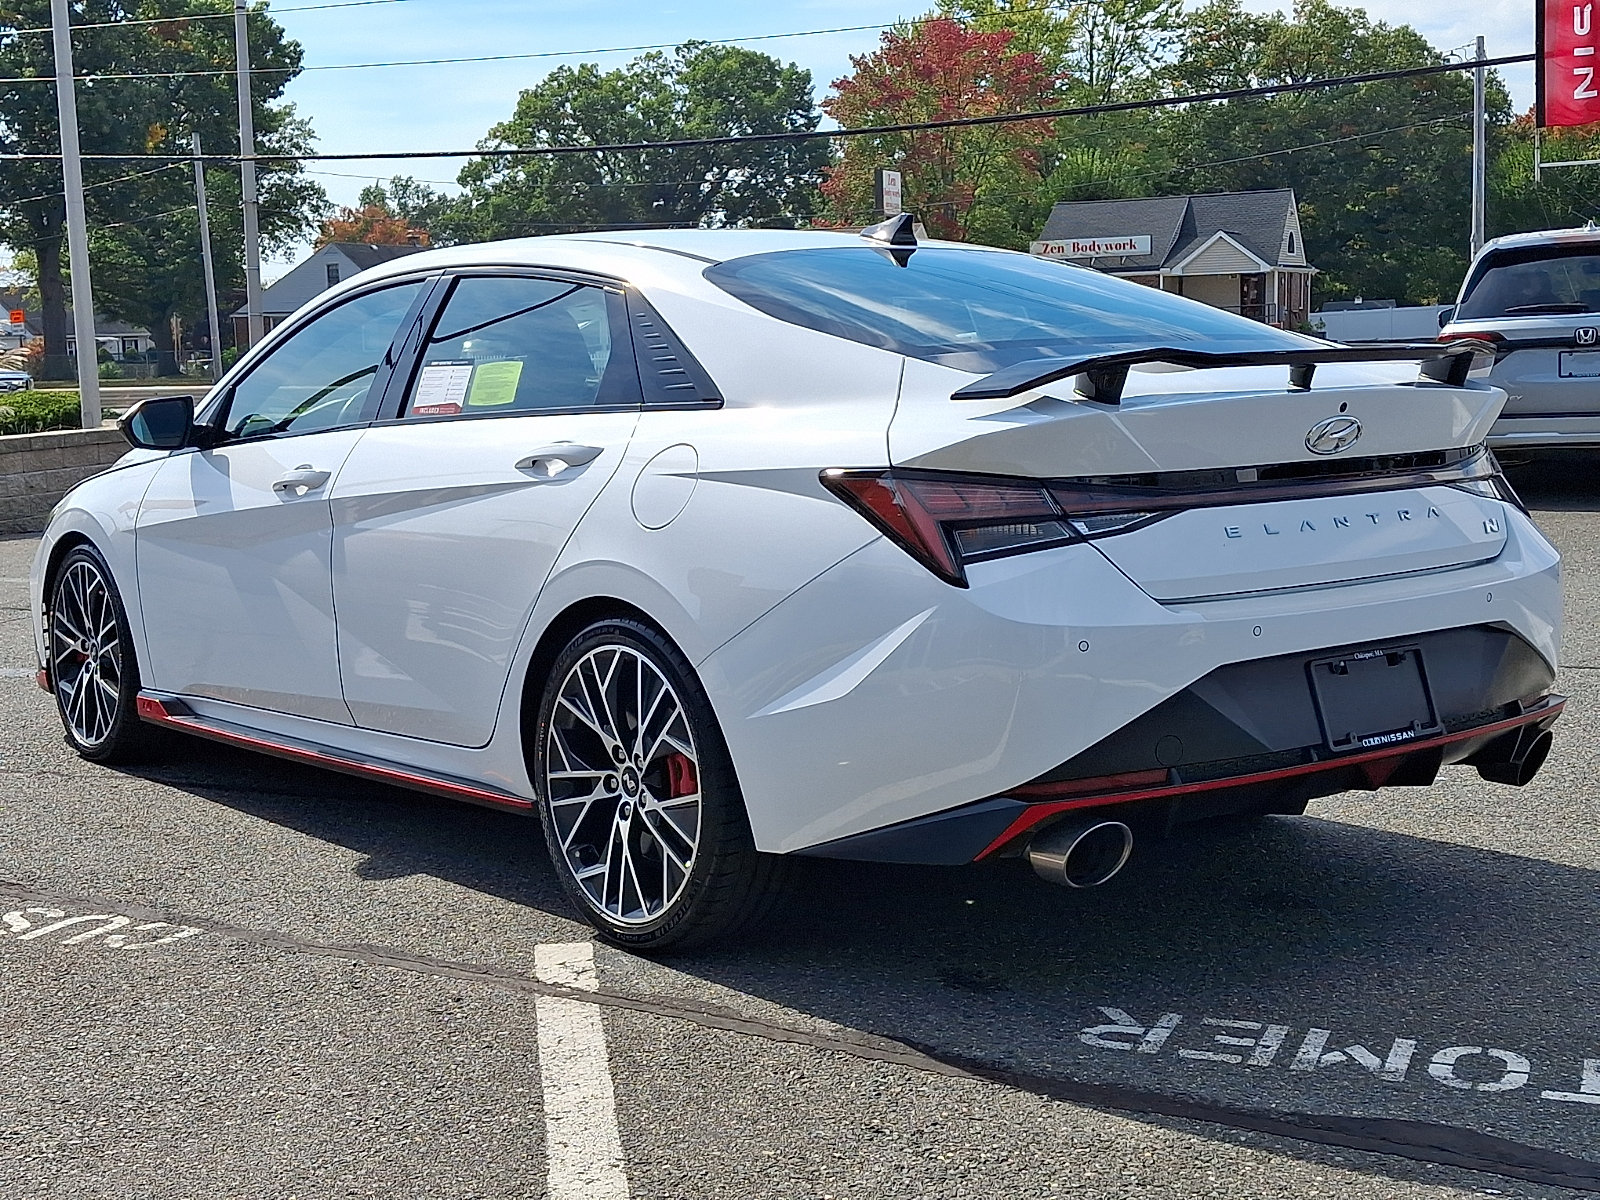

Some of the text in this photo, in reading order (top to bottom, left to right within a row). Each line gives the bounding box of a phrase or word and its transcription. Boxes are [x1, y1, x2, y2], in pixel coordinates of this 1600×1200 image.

[1042, 239, 1138, 255] Zen Bodywork
[1224, 506, 1500, 539] ELANTRA N
[1381, 729, 1415, 744] NISSAN
